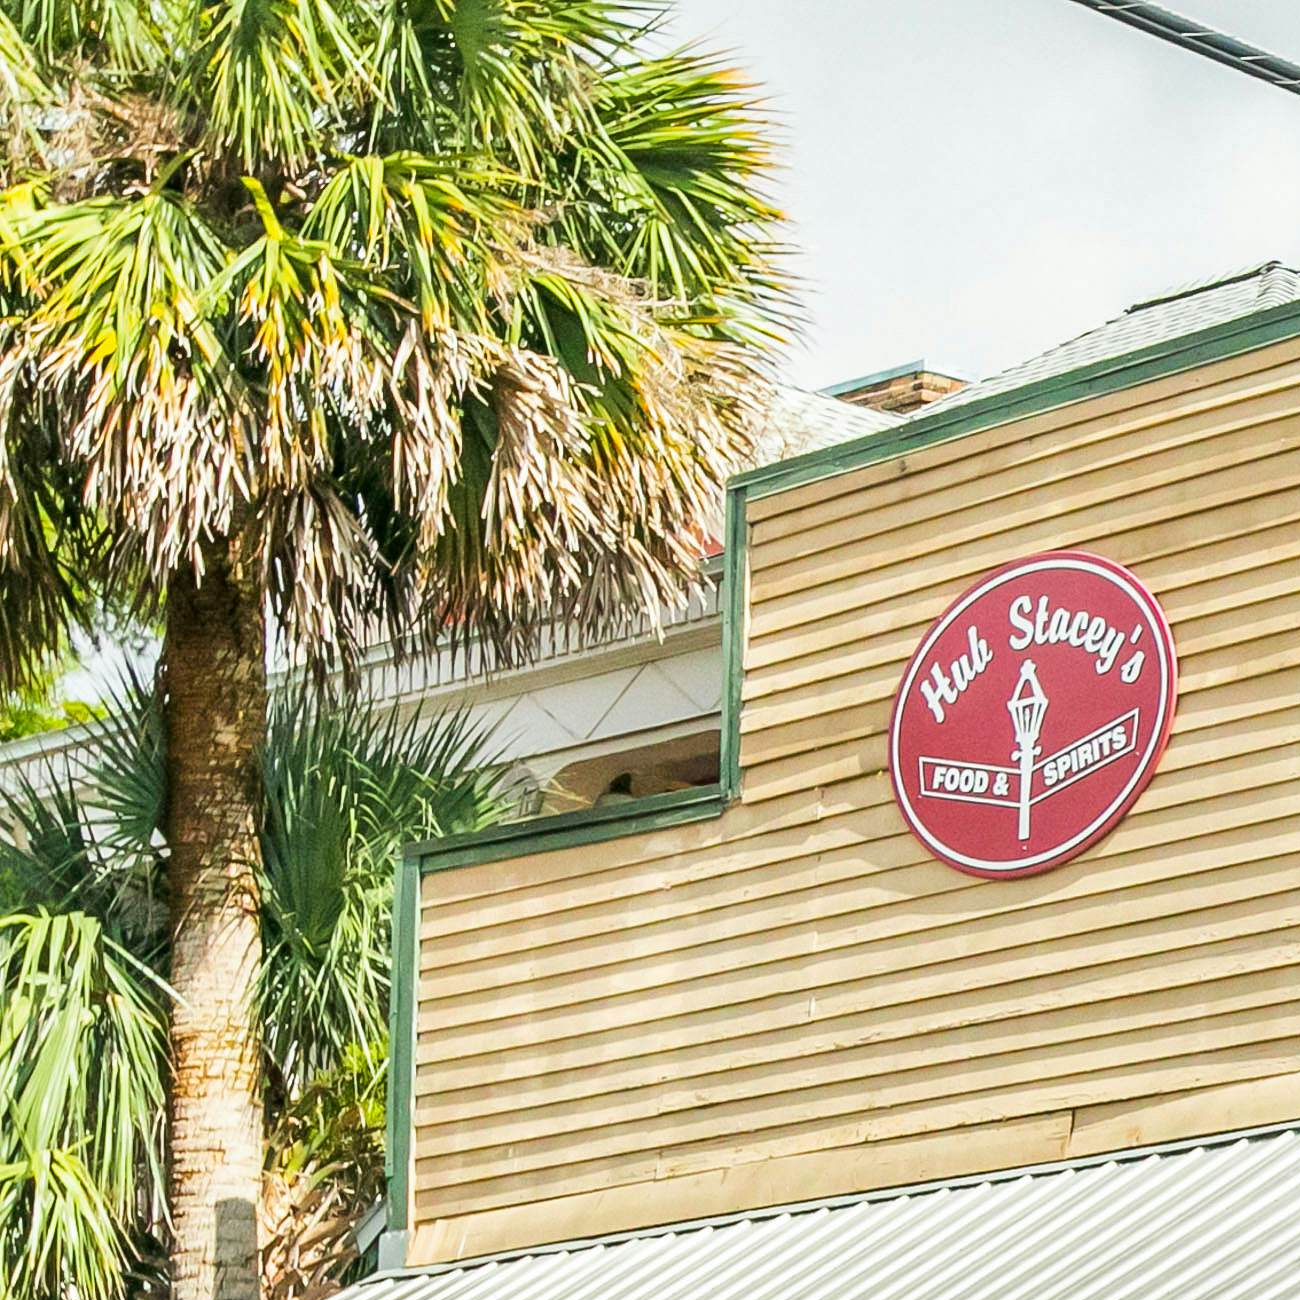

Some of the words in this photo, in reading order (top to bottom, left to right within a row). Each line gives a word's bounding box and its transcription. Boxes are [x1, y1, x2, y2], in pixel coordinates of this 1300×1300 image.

[919, 625, 993, 723] Hub
[1008, 595, 1146, 684] Stacey's
[932, 767, 989, 796] FOOD
[992, 773, 1010, 796] &
[1043, 725, 1127, 787] SPIRITS
